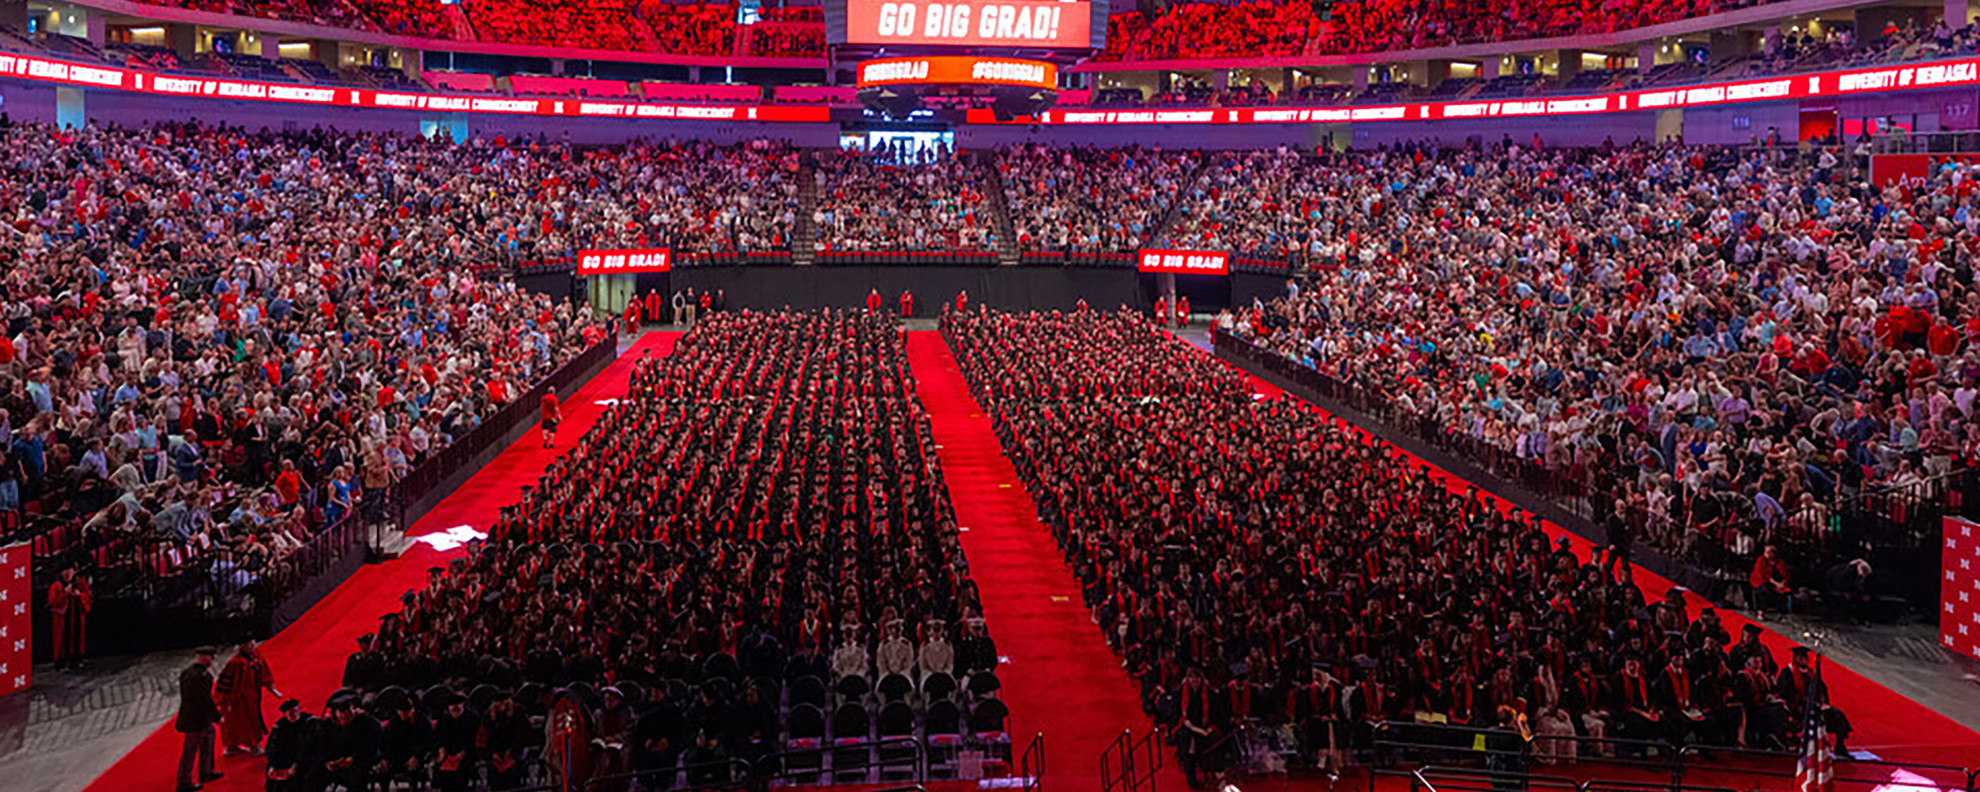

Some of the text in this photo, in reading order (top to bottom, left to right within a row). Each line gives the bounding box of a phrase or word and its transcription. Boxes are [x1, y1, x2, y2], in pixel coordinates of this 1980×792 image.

[879, 3, 1060, 39] GO BIG GRAD!
[1946, 104, 1970, 118] 117
[583, 254, 665, 268] GO BIG GRAD!
[1144, 254, 1224, 268] GO BIG GRAD!
